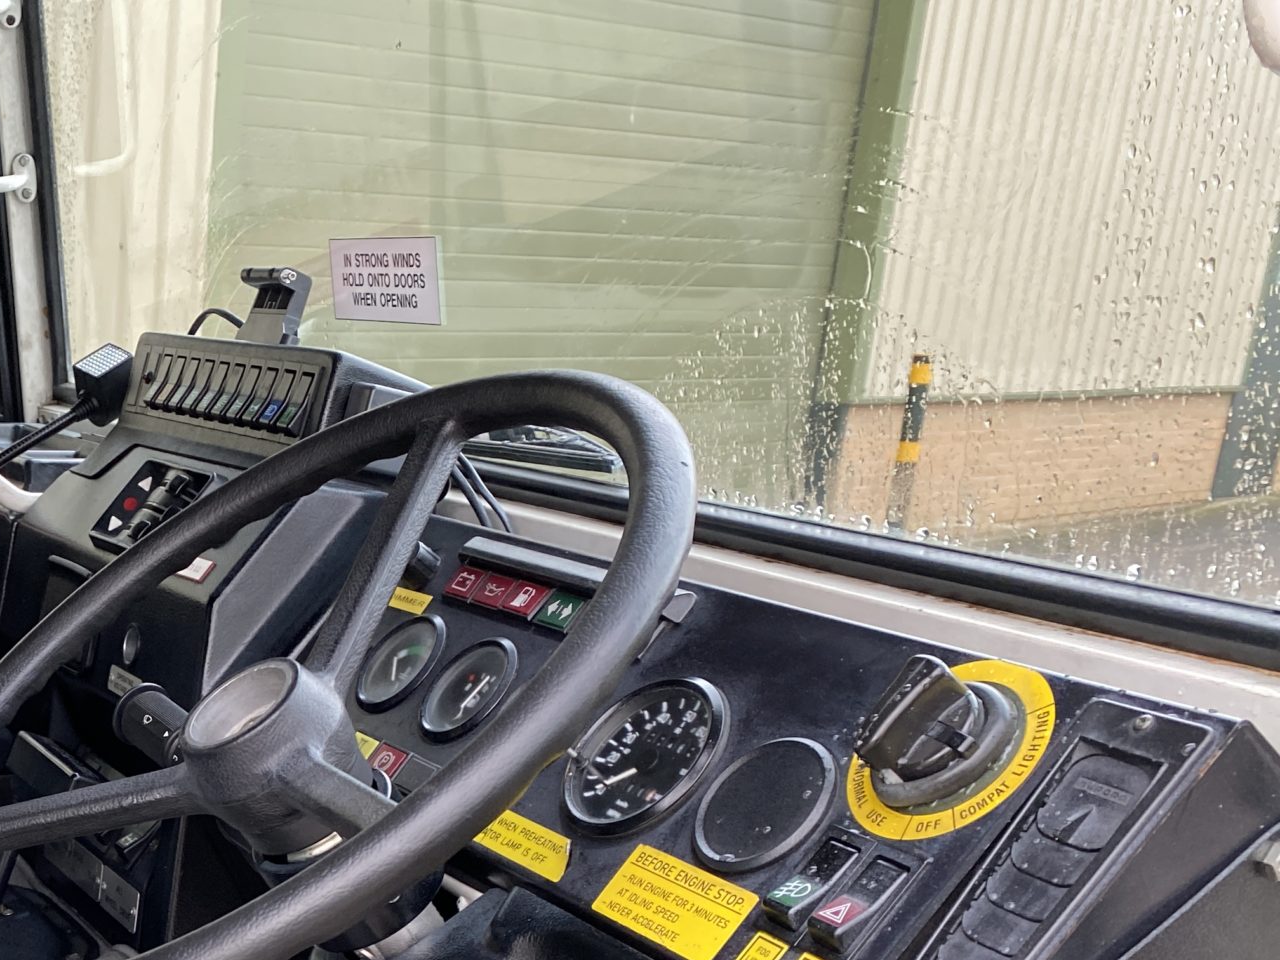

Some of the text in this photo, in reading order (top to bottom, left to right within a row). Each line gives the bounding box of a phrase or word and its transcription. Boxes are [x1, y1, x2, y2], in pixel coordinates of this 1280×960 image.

[343, 252, 421, 268] IN STRONG WINDS
[342, 273, 426, 289] HOLD ONTO DOORS
[352, 292, 418, 309] WHEN OPENING
[394, 594, 426, 607] IMMER
[1011, 710, 1050, 777] LIGHTING
[852, 765, 887, 826] NORMAL USE
[497, 818, 564, 855] WHEN PREHEATING
[915, 819, 942, 833] OFF
[482, 828, 548, 864] ATOR LAMP IS OFF
[635, 852, 677, 877] BEFORE
[674, 868, 716, 898] ENGINE
[616, 887, 680, 924] AT IDLING SPEED
[627, 873, 646, 888] RUN
[642, 881, 674, 902] ENGINE
[671, 895, 690, 910] FOR
[686, 903, 695, 913] 3
[692, 904, 730, 930] MINUTES
[606, 900, 633, 918] NEVER
[631, 913, 680, 943] ACCELERATE
[755, 946, 772, 958] FOG
